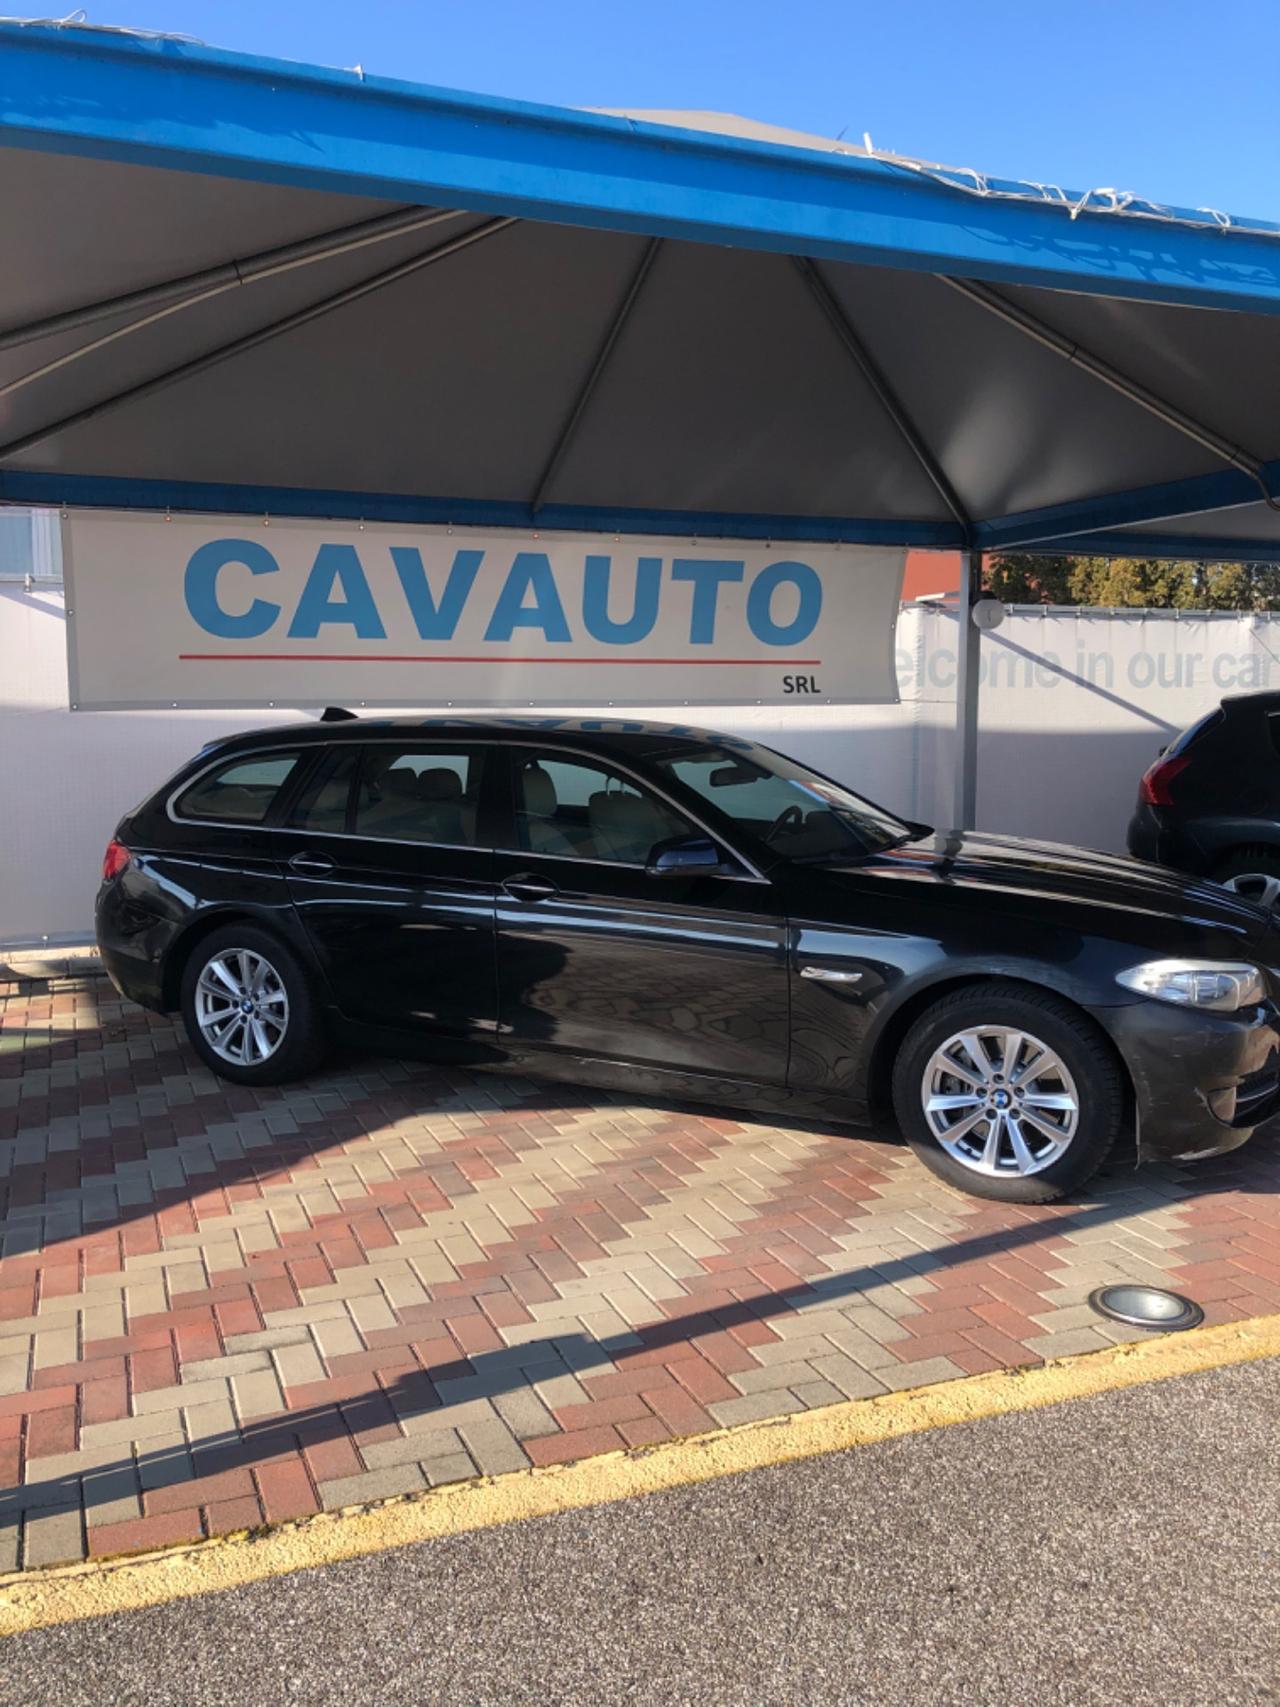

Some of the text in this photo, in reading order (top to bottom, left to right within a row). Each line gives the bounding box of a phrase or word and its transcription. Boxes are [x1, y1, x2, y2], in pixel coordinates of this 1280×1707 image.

[184, 538, 823, 646] CAVAUTO
[783, 676, 821, 694] SRL
[896, 637, 1061, 688] elcme
[1078, 640, 1115, 688] in
[1127, 651, 1204, 689] our
